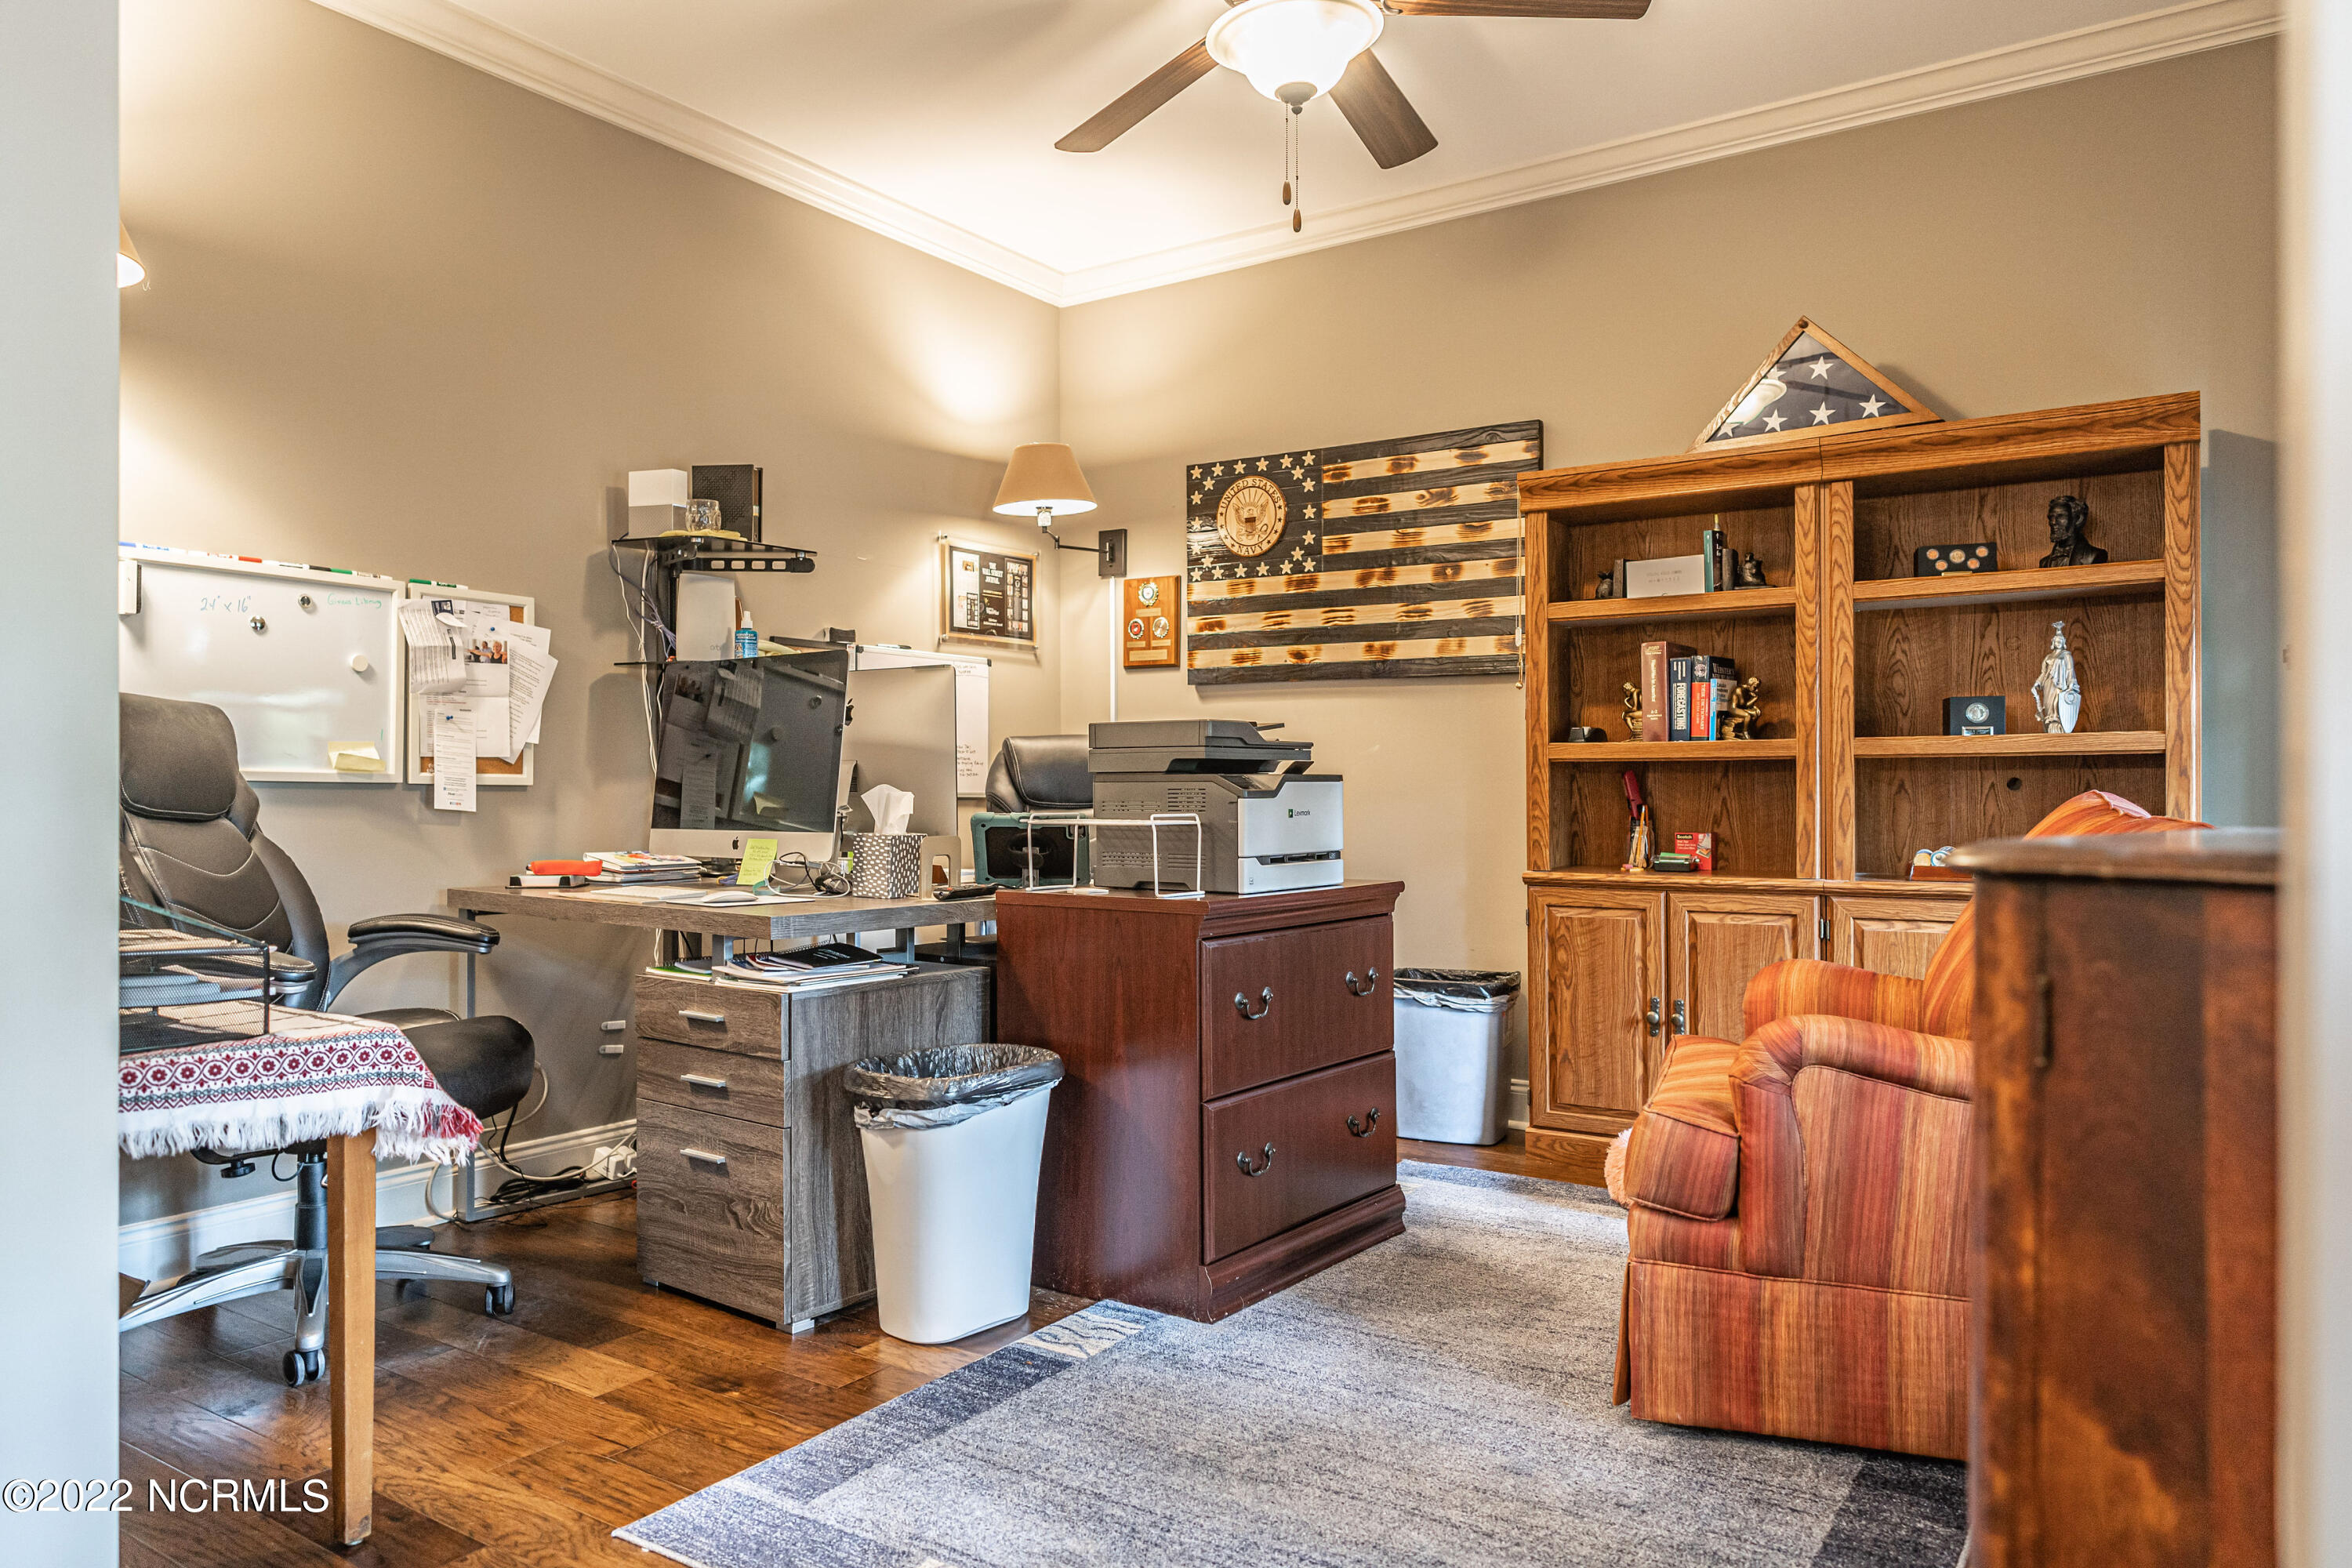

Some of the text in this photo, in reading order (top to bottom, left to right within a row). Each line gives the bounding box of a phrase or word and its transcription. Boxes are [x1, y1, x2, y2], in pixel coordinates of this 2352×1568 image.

[1220, 478, 1281, 509] UNITED STATES
[1236, 543, 1264, 555] NAVY
[1676, 683, 1686, 730] FORECASTING
